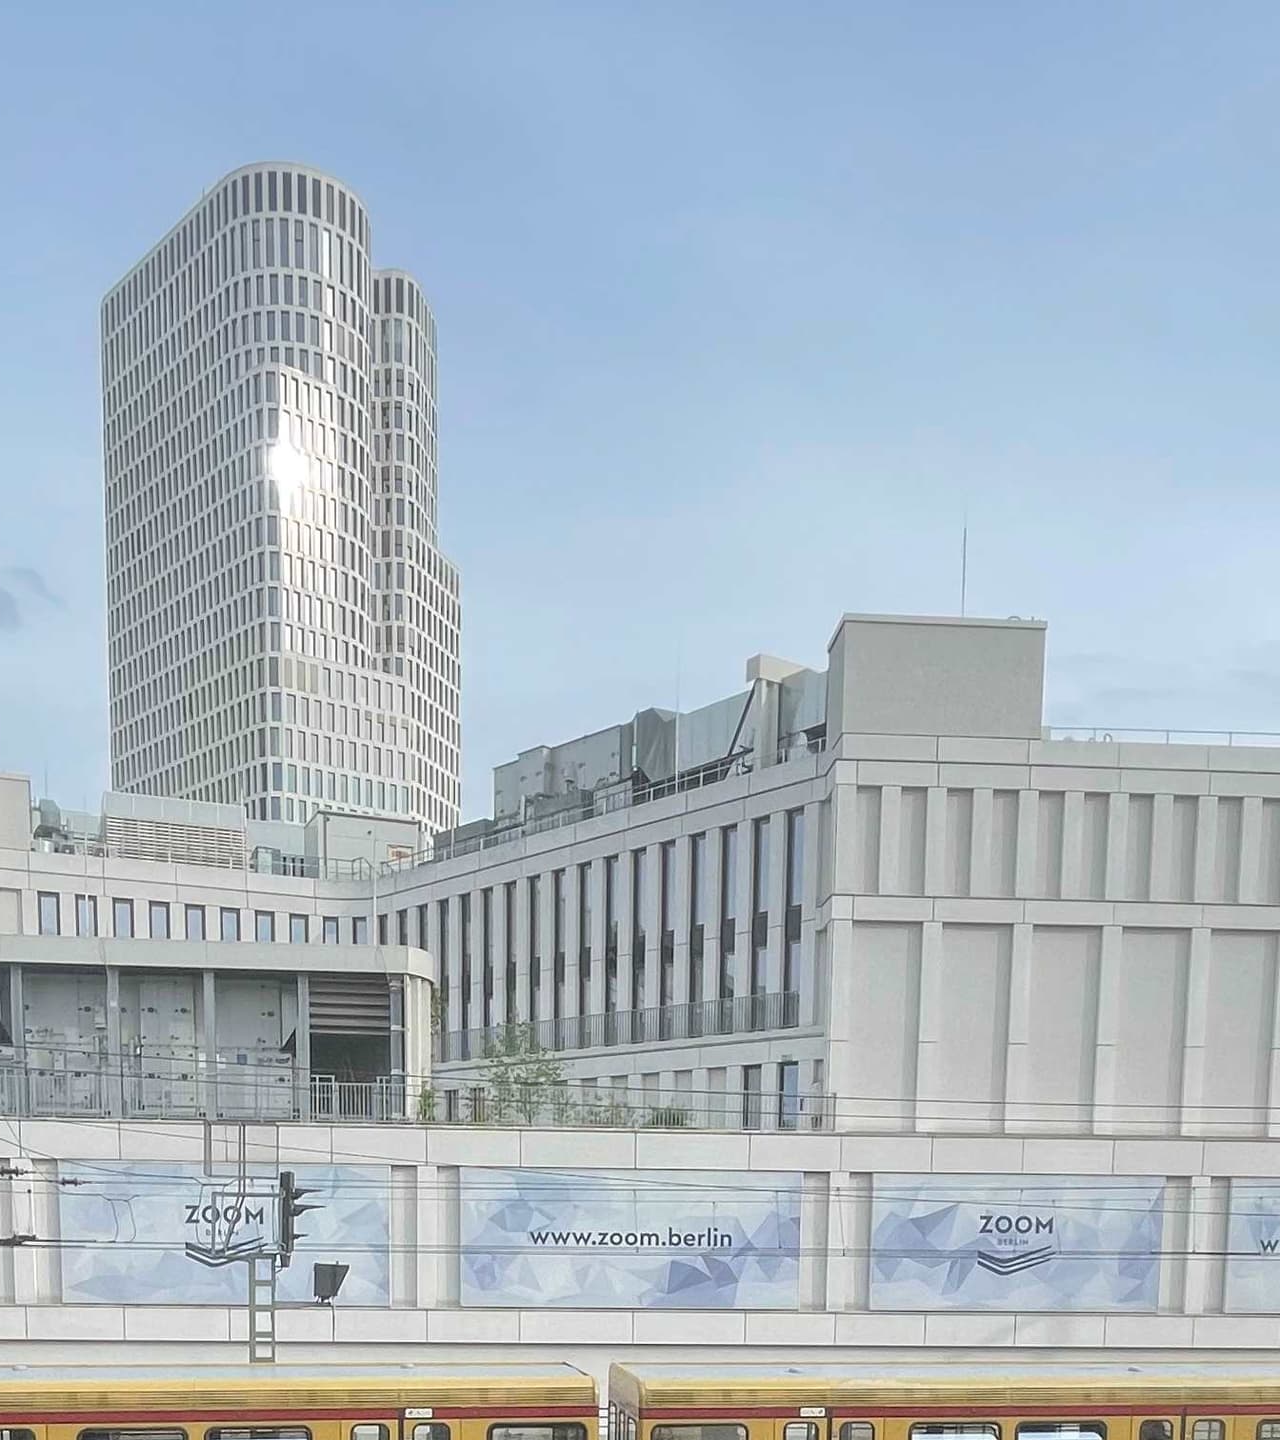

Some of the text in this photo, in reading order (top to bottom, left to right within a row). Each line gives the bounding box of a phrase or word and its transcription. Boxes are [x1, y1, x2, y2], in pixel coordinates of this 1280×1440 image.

[185, 1205, 264, 1225] ZOOM
[979, 1215, 1054, 1234] ZOOM
[529, 1227, 733, 1247] www.zoom.berlin
[997, 1238, 1029, 1246] BERLIN
